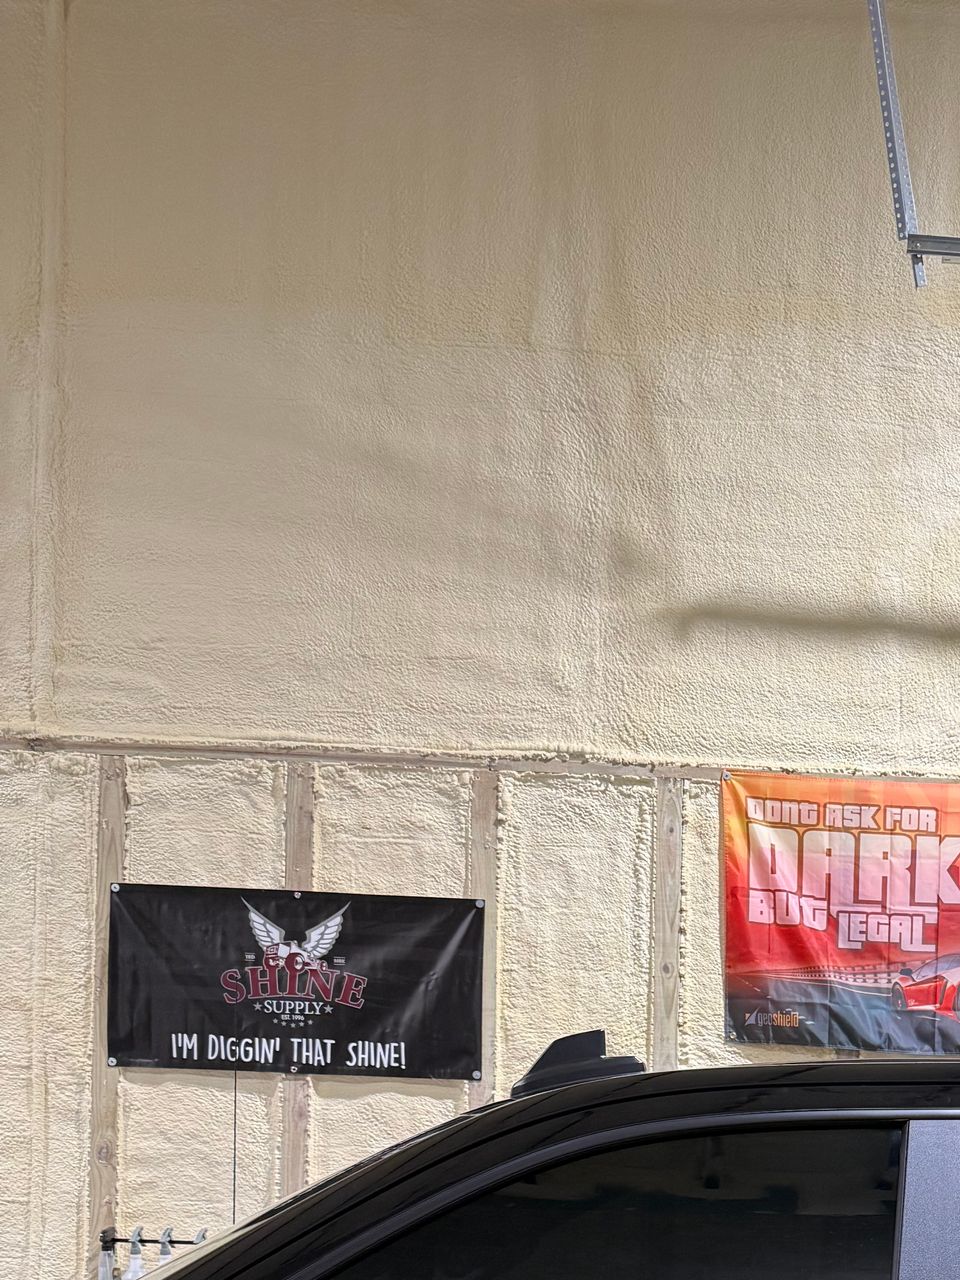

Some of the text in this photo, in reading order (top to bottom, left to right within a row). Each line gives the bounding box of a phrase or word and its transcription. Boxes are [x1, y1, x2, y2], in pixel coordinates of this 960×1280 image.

[825, 804, 879, 829] ASK
[885, 807, 937, 832] FOR
[748, 890, 828, 931] BUT
[838, 913, 937, 952] LEGAL
[220, 964, 368, 1009] SHINE
[264, 1000, 325, 1015] SUPPLY
[171, 1033, 406, 1069] I'M DIGGIN' THAT SHINE!
